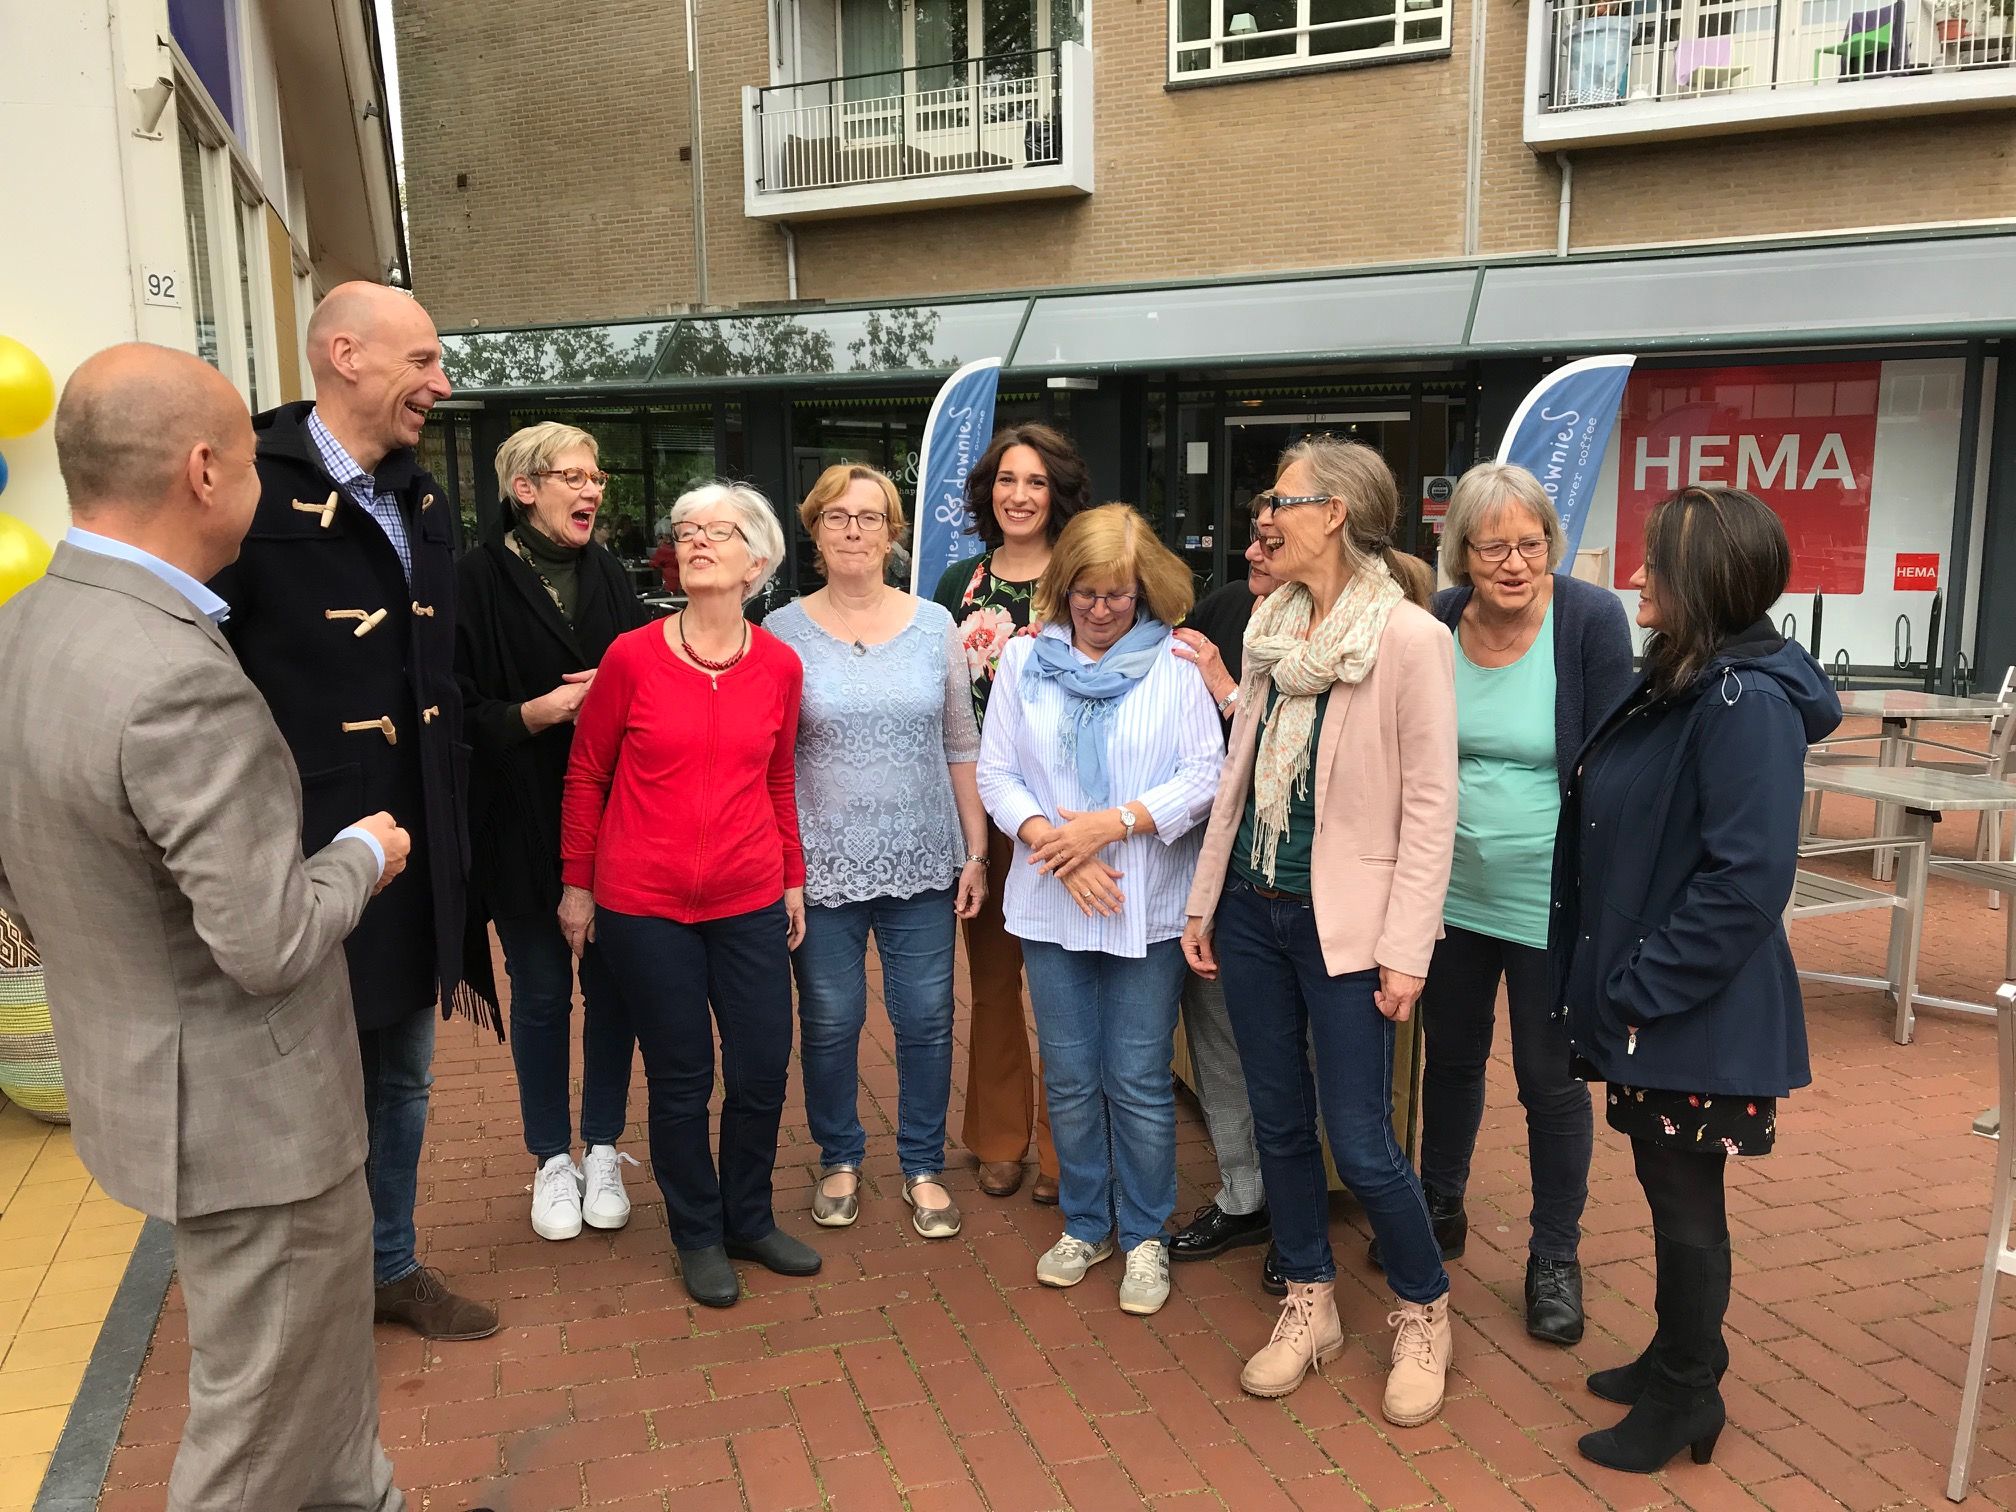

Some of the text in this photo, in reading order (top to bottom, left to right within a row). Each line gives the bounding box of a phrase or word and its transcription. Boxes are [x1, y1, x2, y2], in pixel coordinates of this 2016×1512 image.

[148, 274, 175, 298] 92
[1567, 417, 1597, 507] over coffee
[1633, 432, 1858, 491] HEMA
[1896, 566, 1936, 578] HEMA
